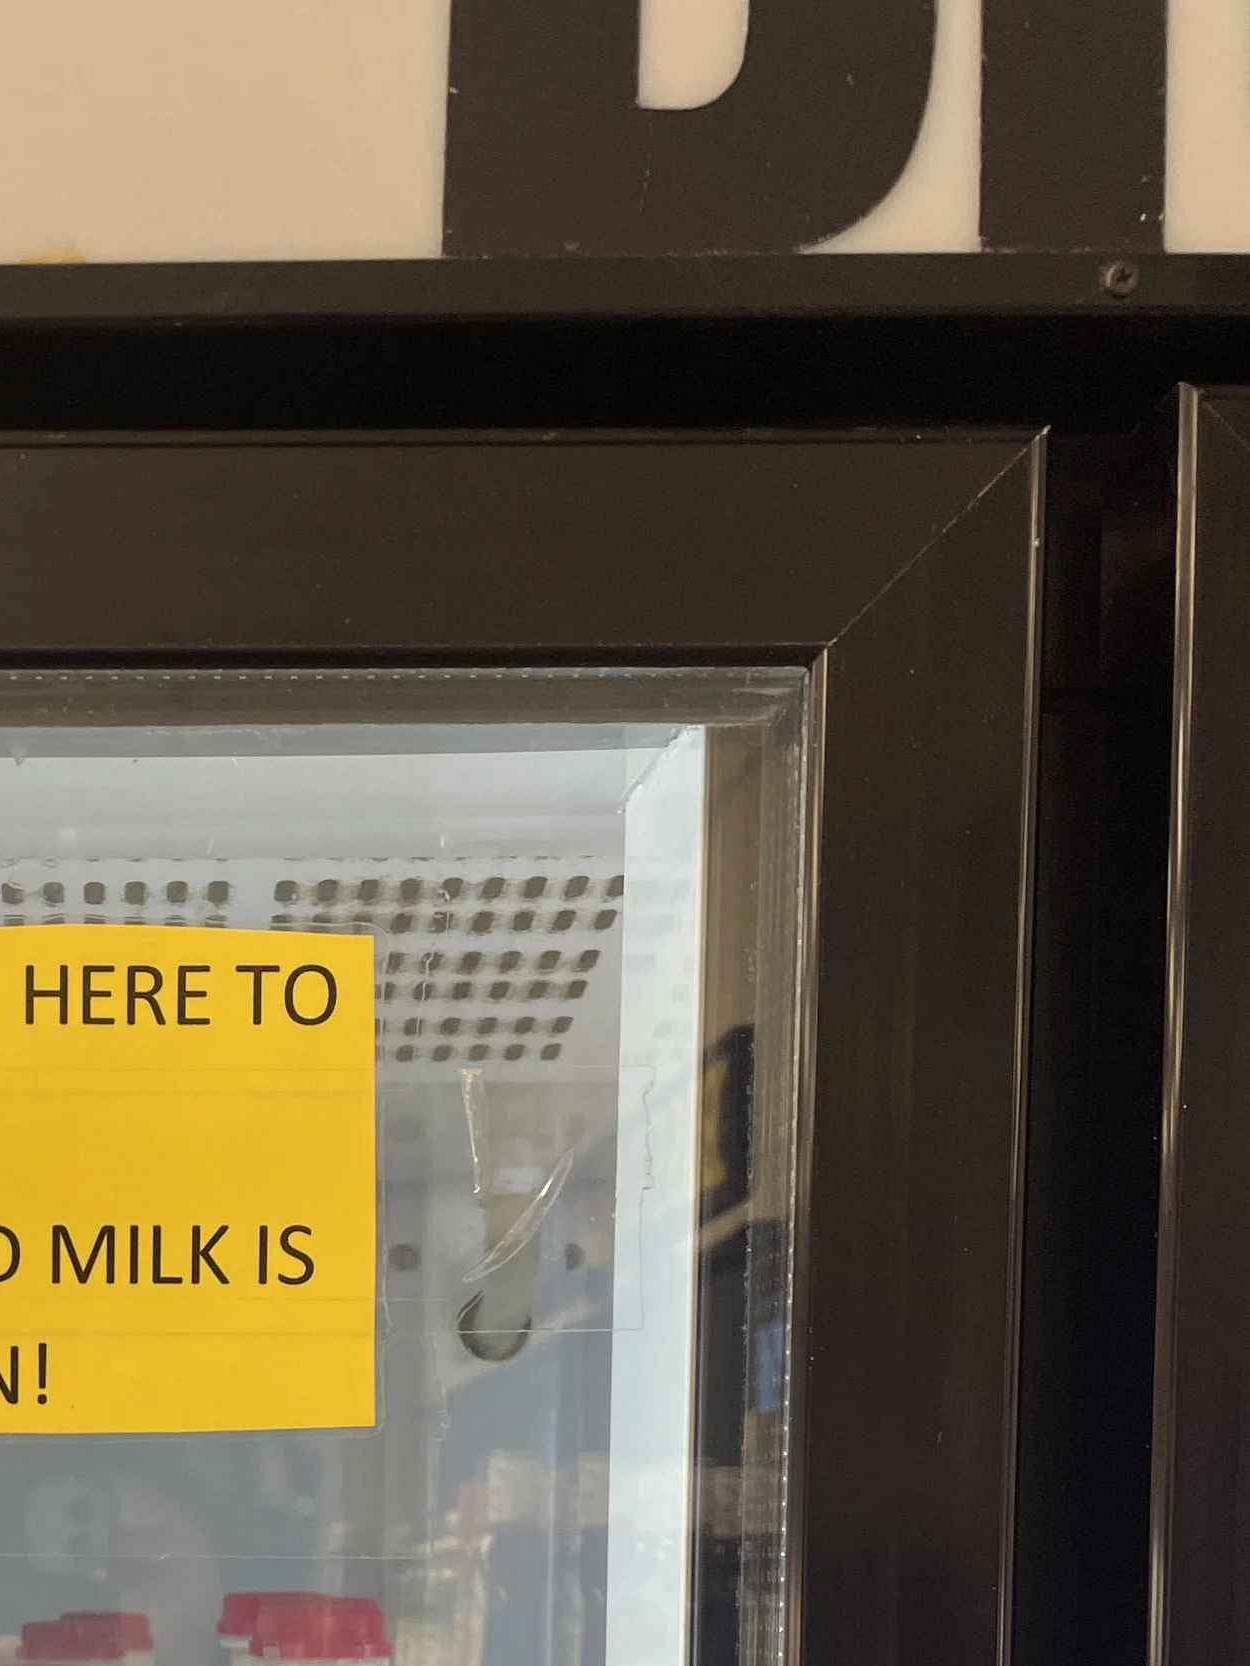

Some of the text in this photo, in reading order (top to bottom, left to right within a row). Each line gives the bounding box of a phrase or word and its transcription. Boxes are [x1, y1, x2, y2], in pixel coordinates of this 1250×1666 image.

[24, 964, 211, 1026] HERE
[234, 964, 338, 1026] TO
[50, 1224, 230, 1286] MILK
[257, 1224, 315, 1286] IS
